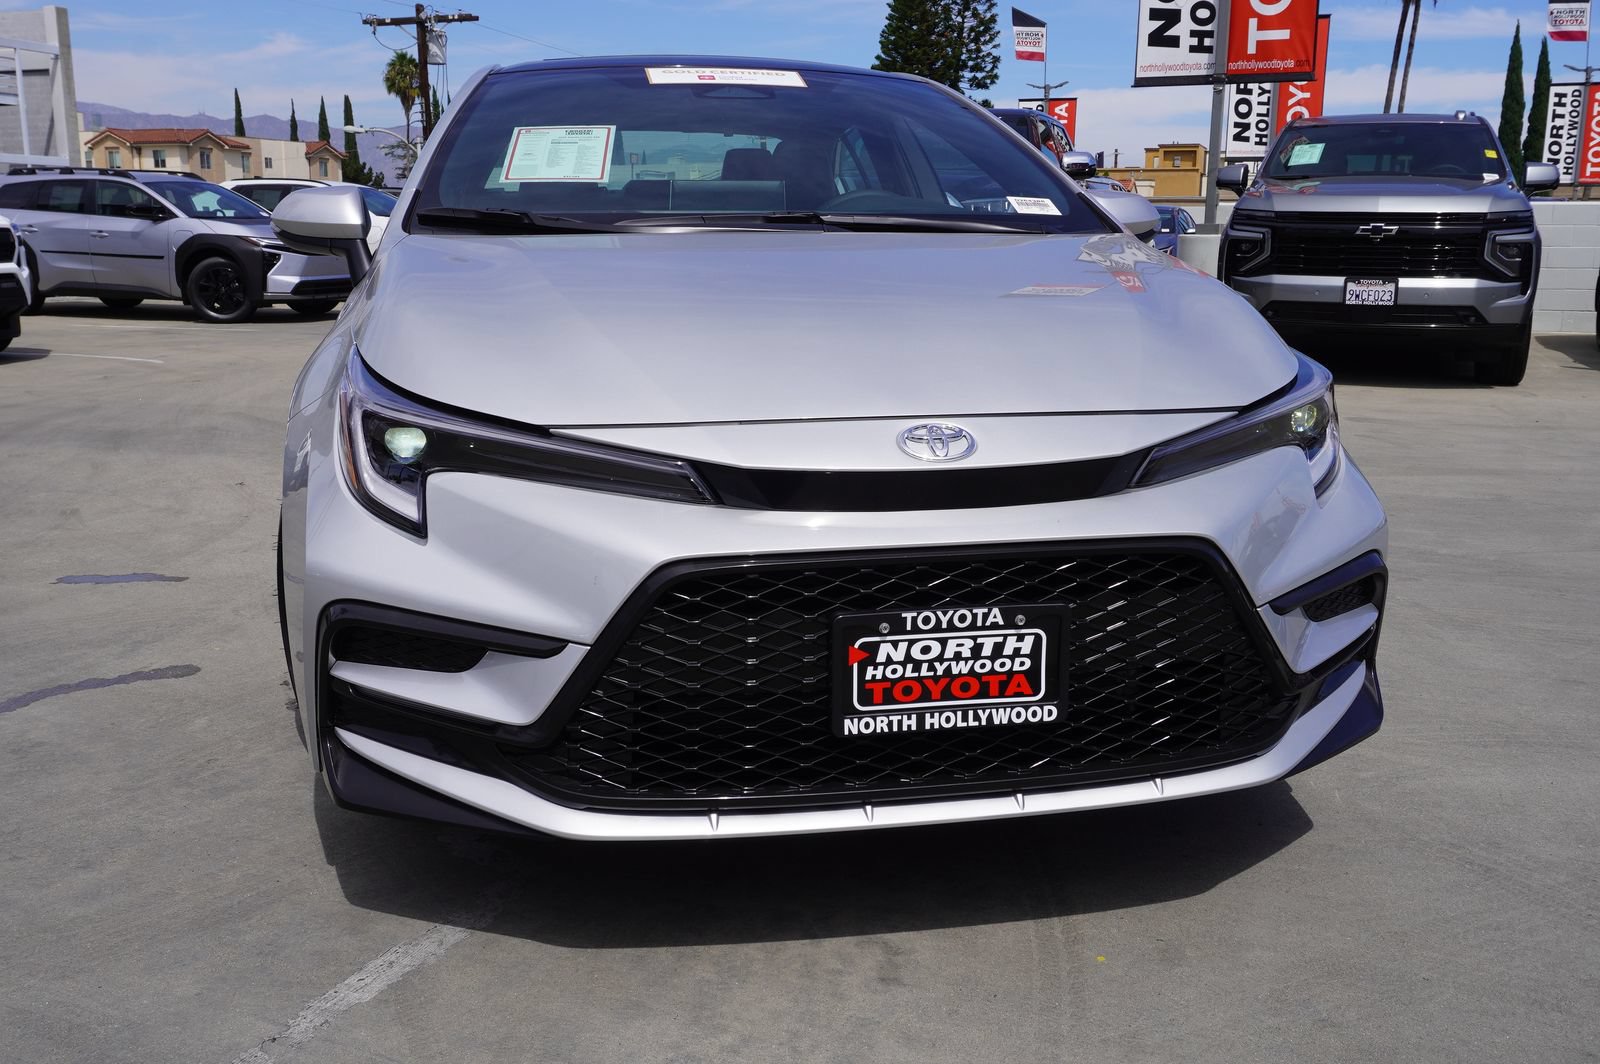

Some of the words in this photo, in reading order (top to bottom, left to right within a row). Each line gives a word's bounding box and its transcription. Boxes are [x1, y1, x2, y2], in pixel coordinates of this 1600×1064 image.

[1148, 0, 1181, 48] N
[1562, 89, 1582, 176] HOLLYWOOD
[1348, 289, 1394, 302] 9WCF023
[902, 608, 1004, 631] TOYOTA
[875, 635, 1035, 663] NORTH
[865, 657, 1032, 680] HOLLYWOOD
[864, 673, 1033, 705] TOYOTA
[844, 714, 917, 736] NORTH
[925, 705, 1058, 730] HOLLYWOOD
